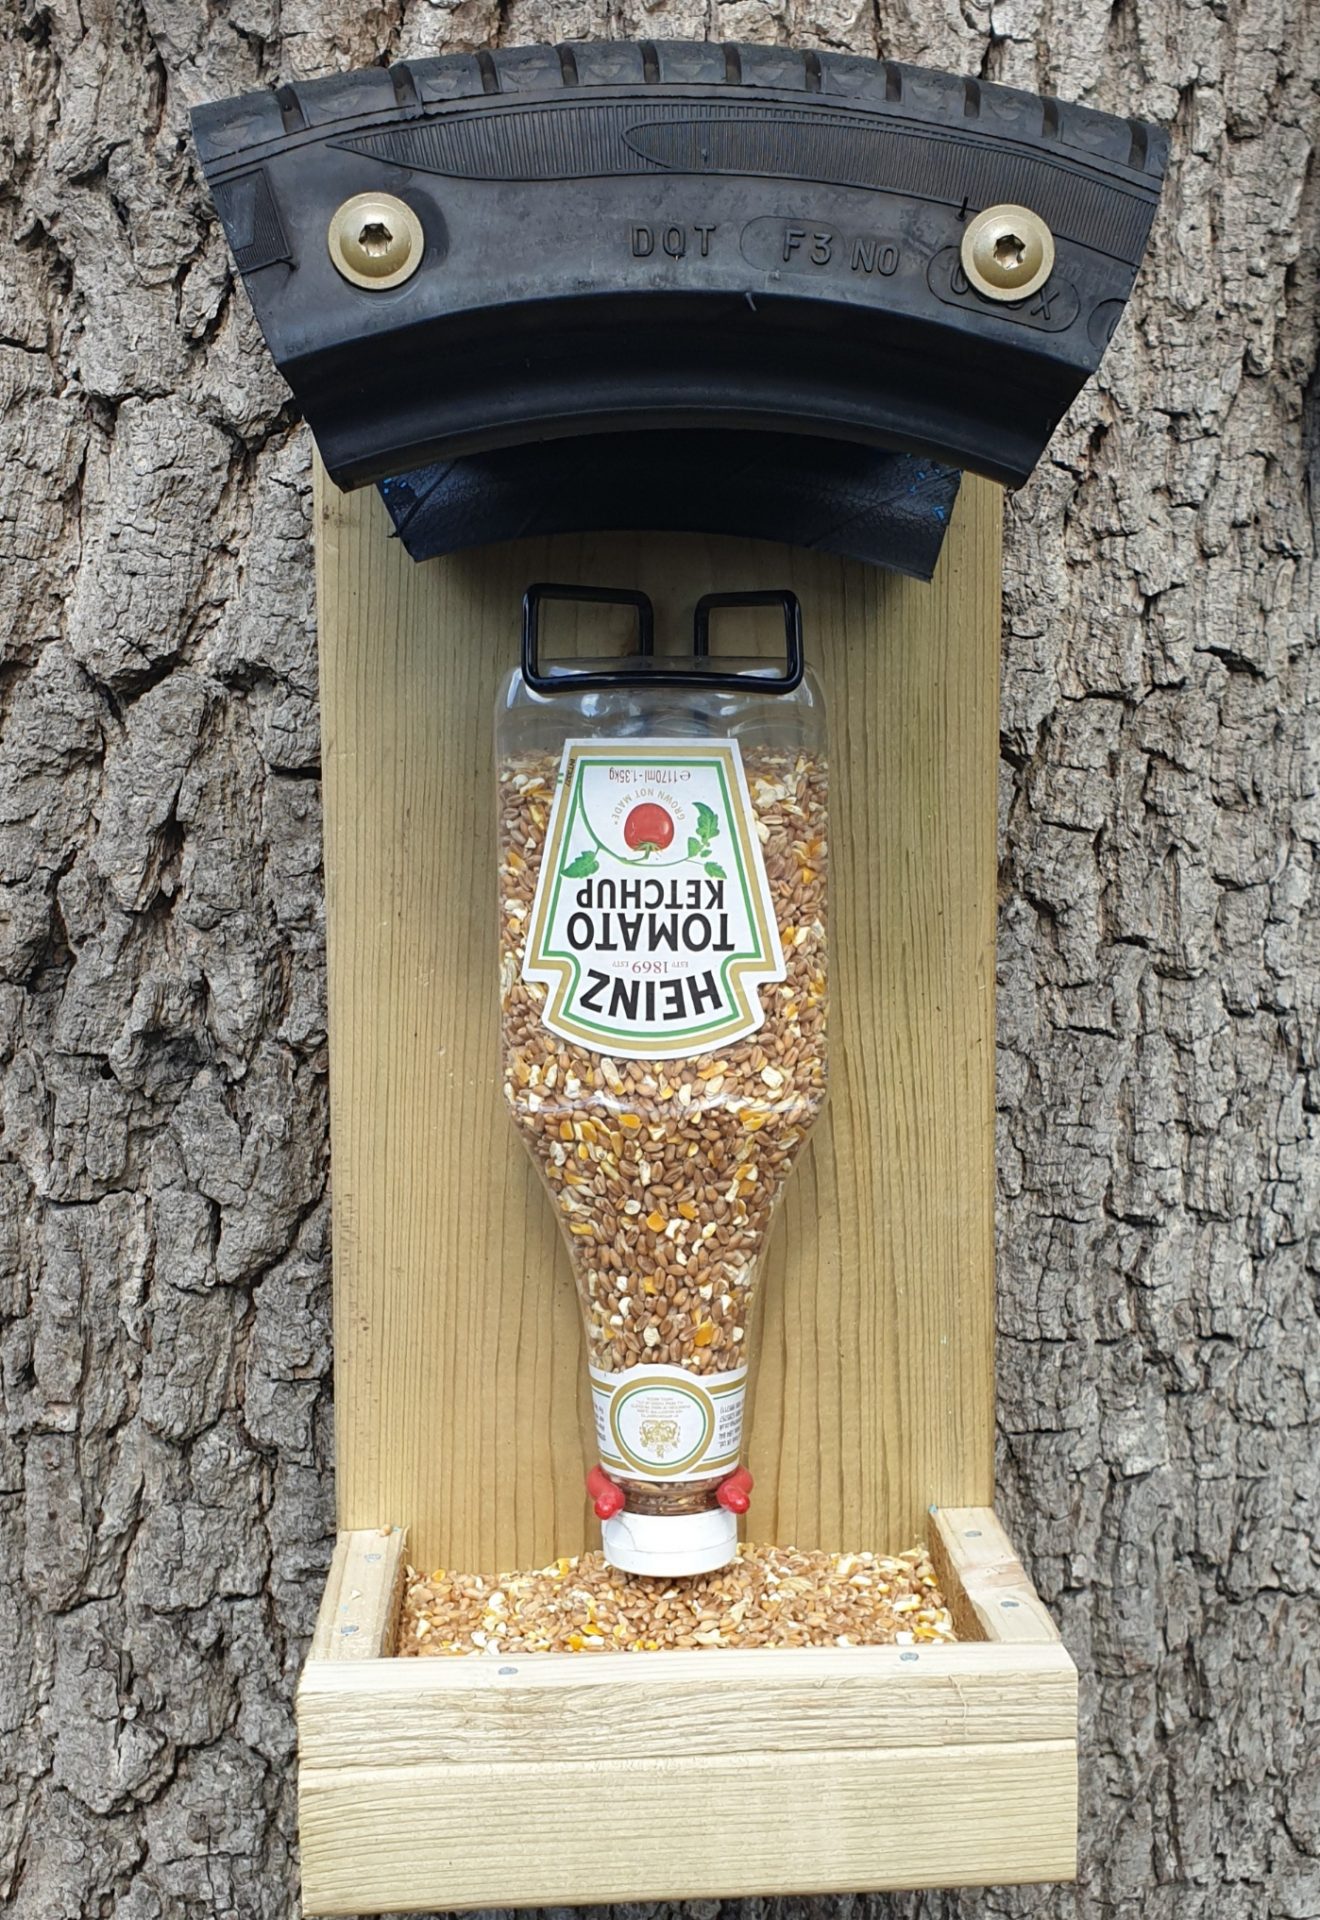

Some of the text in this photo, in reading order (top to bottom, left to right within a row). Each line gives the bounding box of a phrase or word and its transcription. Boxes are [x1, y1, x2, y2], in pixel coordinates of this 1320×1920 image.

[783, 228, 833, 266] F3
[635, 788, 654, 799] NOT
[657, 791, 686, 821] GROWN
[576, 878, 724, 910] KETCHUP
[566, 911, 735, 952] TOMATO
[632, 961, 668, 974] 1869
[579, 968, 723, 1021] HEINZ
